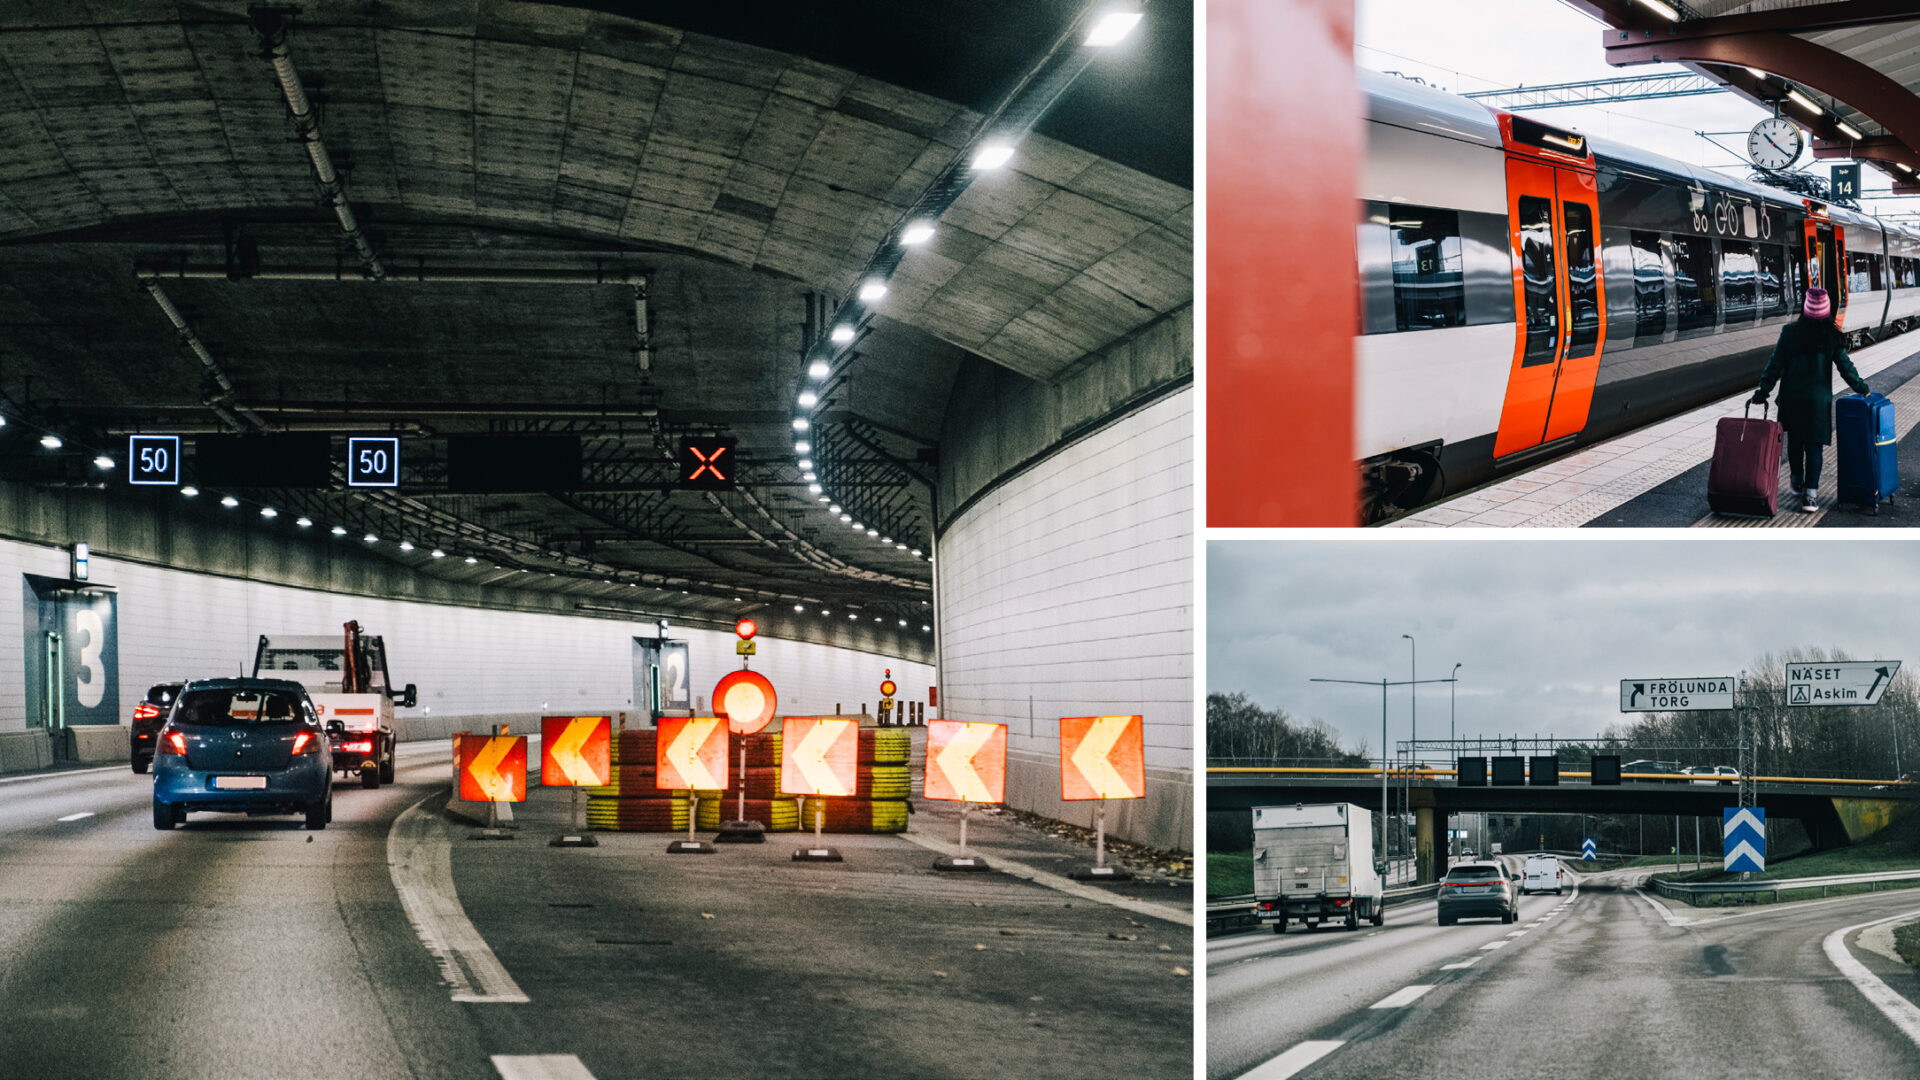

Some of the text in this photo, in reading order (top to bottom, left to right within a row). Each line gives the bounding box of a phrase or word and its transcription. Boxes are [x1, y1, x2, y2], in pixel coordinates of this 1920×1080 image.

[1837, 181, 1853, 195] 14
[140, 447, 168, 473] 50
[359, 449, 387, 474] 50
[76, 609, 105, 709] 3
[667, 652, 688, 702] 2
[1791, 666, 1841, 681] NÄSET
[1650, 680, 1728, 694] FRÖLUNDA
[1813, 687, 1858, 700] Askim
[1650, 696, 1690, 707] TORG
